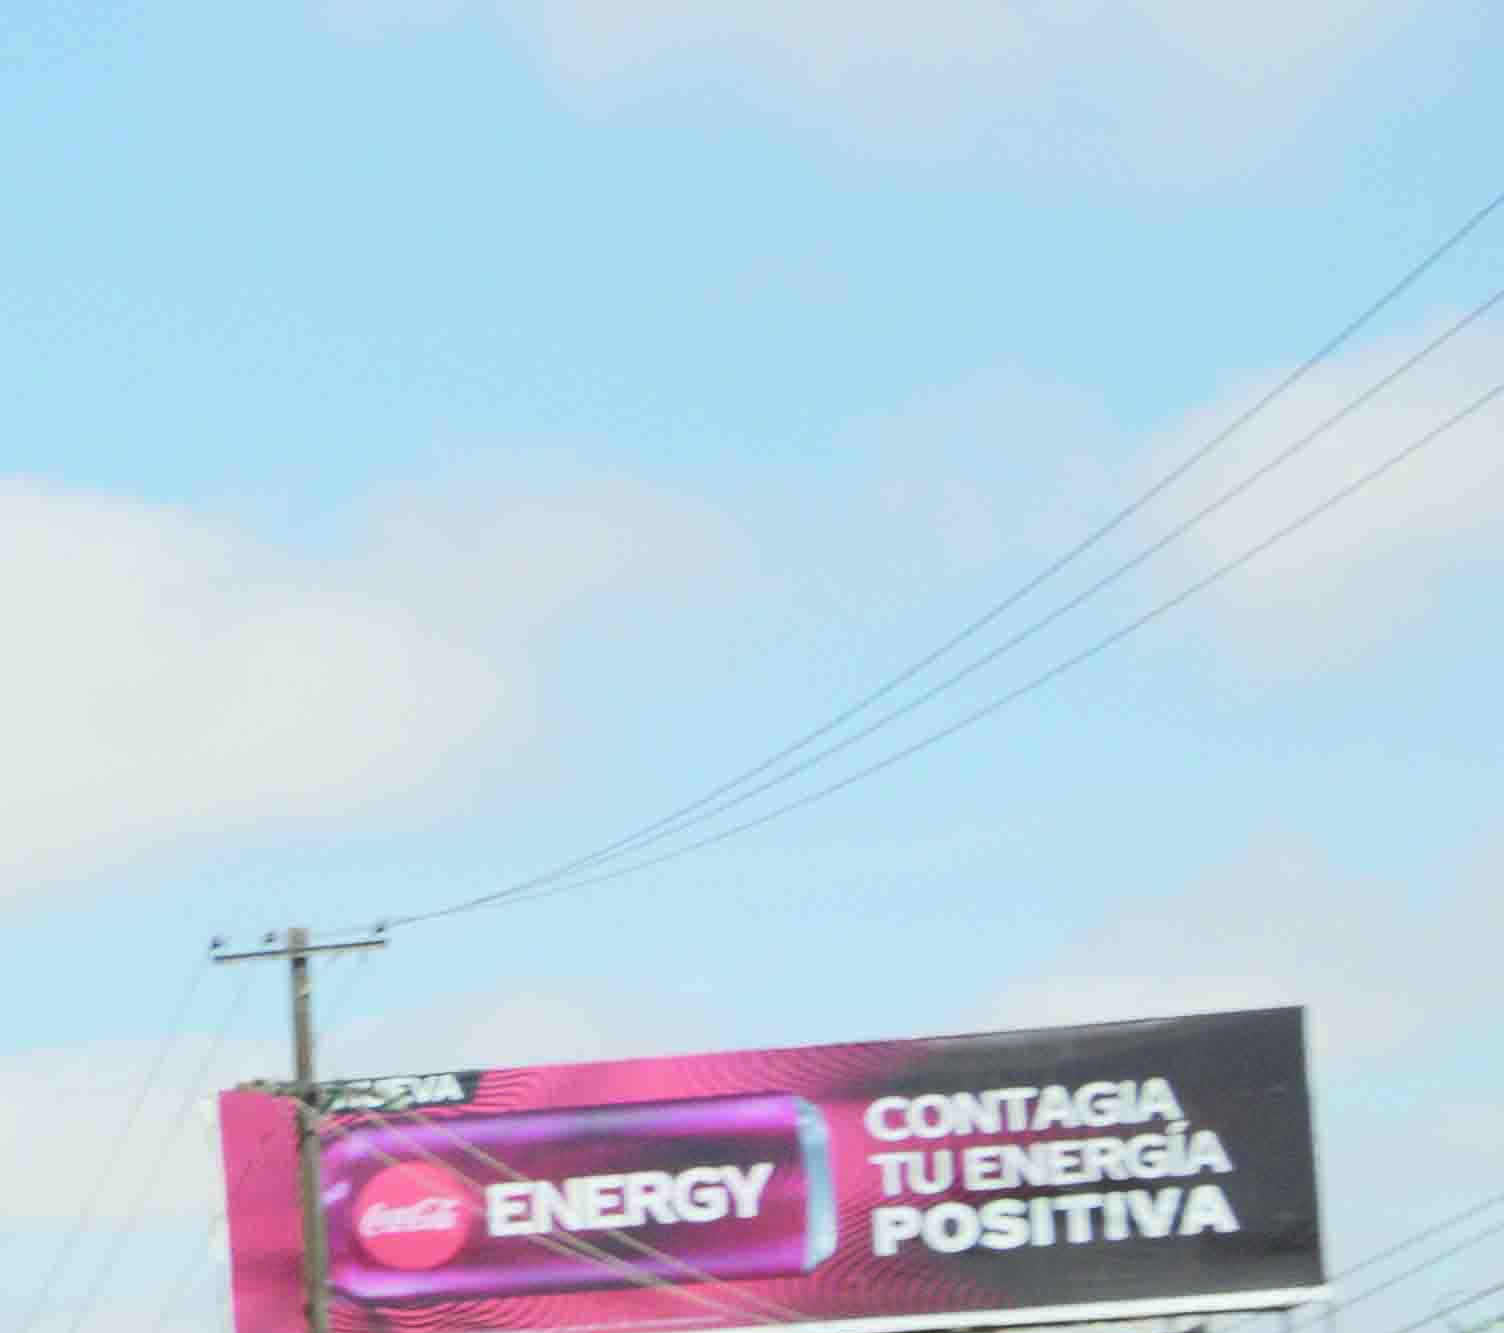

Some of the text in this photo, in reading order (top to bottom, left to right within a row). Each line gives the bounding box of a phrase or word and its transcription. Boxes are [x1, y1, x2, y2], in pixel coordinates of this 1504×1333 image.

[864, 1076, 1185, 1142] CONTAGIA
[868, 1121, 1233, 1197] TU ENERGÍA
[486, 1162, 775, 1237] ENERGY
[870, 1184, 1239, 1257] POSITIVA
